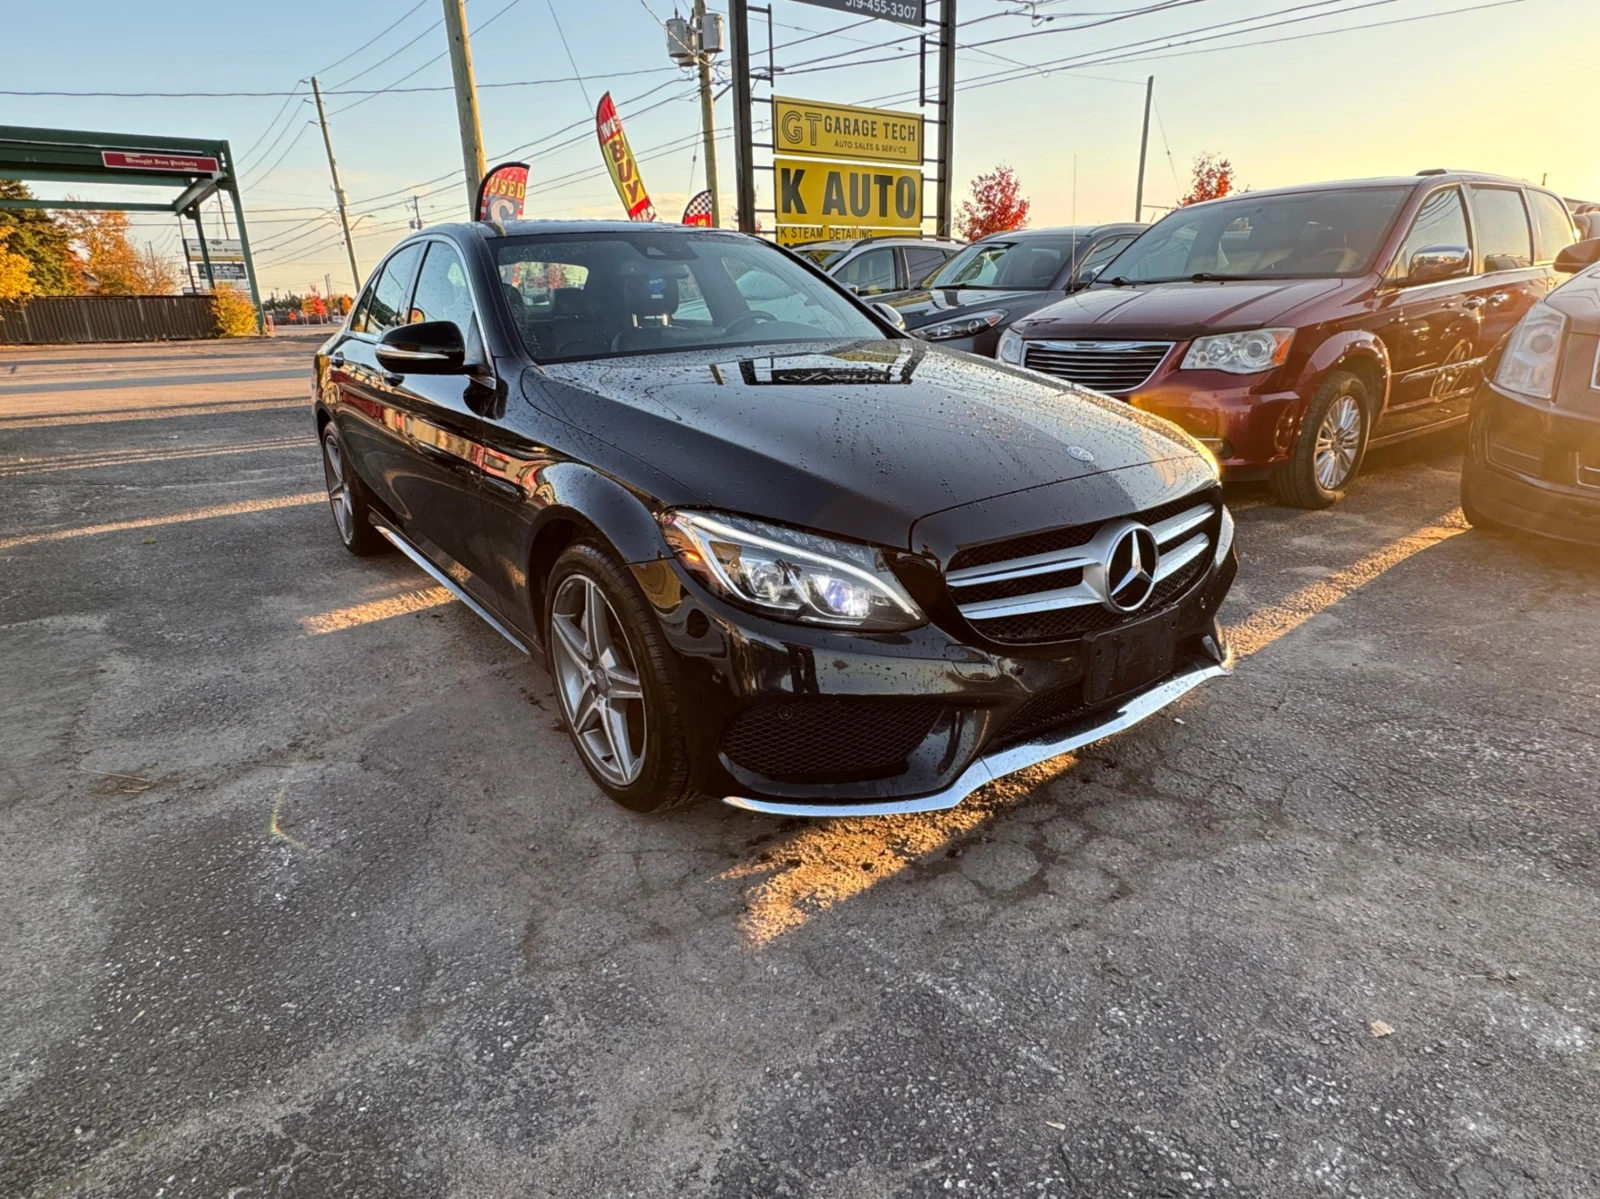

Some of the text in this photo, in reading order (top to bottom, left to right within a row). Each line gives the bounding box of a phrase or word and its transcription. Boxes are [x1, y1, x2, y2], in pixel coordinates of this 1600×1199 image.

[600, 115, 620, 140] WE
[781, 110, 822, 147] GT
[824, 115, 916, 142] GARAGE TECH
[834, 140, 907, 154] AUTO SALES & SERVICE
[609, 139, 640, 204] BUY
[490, 176, 525, 200] USED
[781, 167, 916, 219] K AUTO
[780, 226, 873, 240] K STEAM DETAILING
